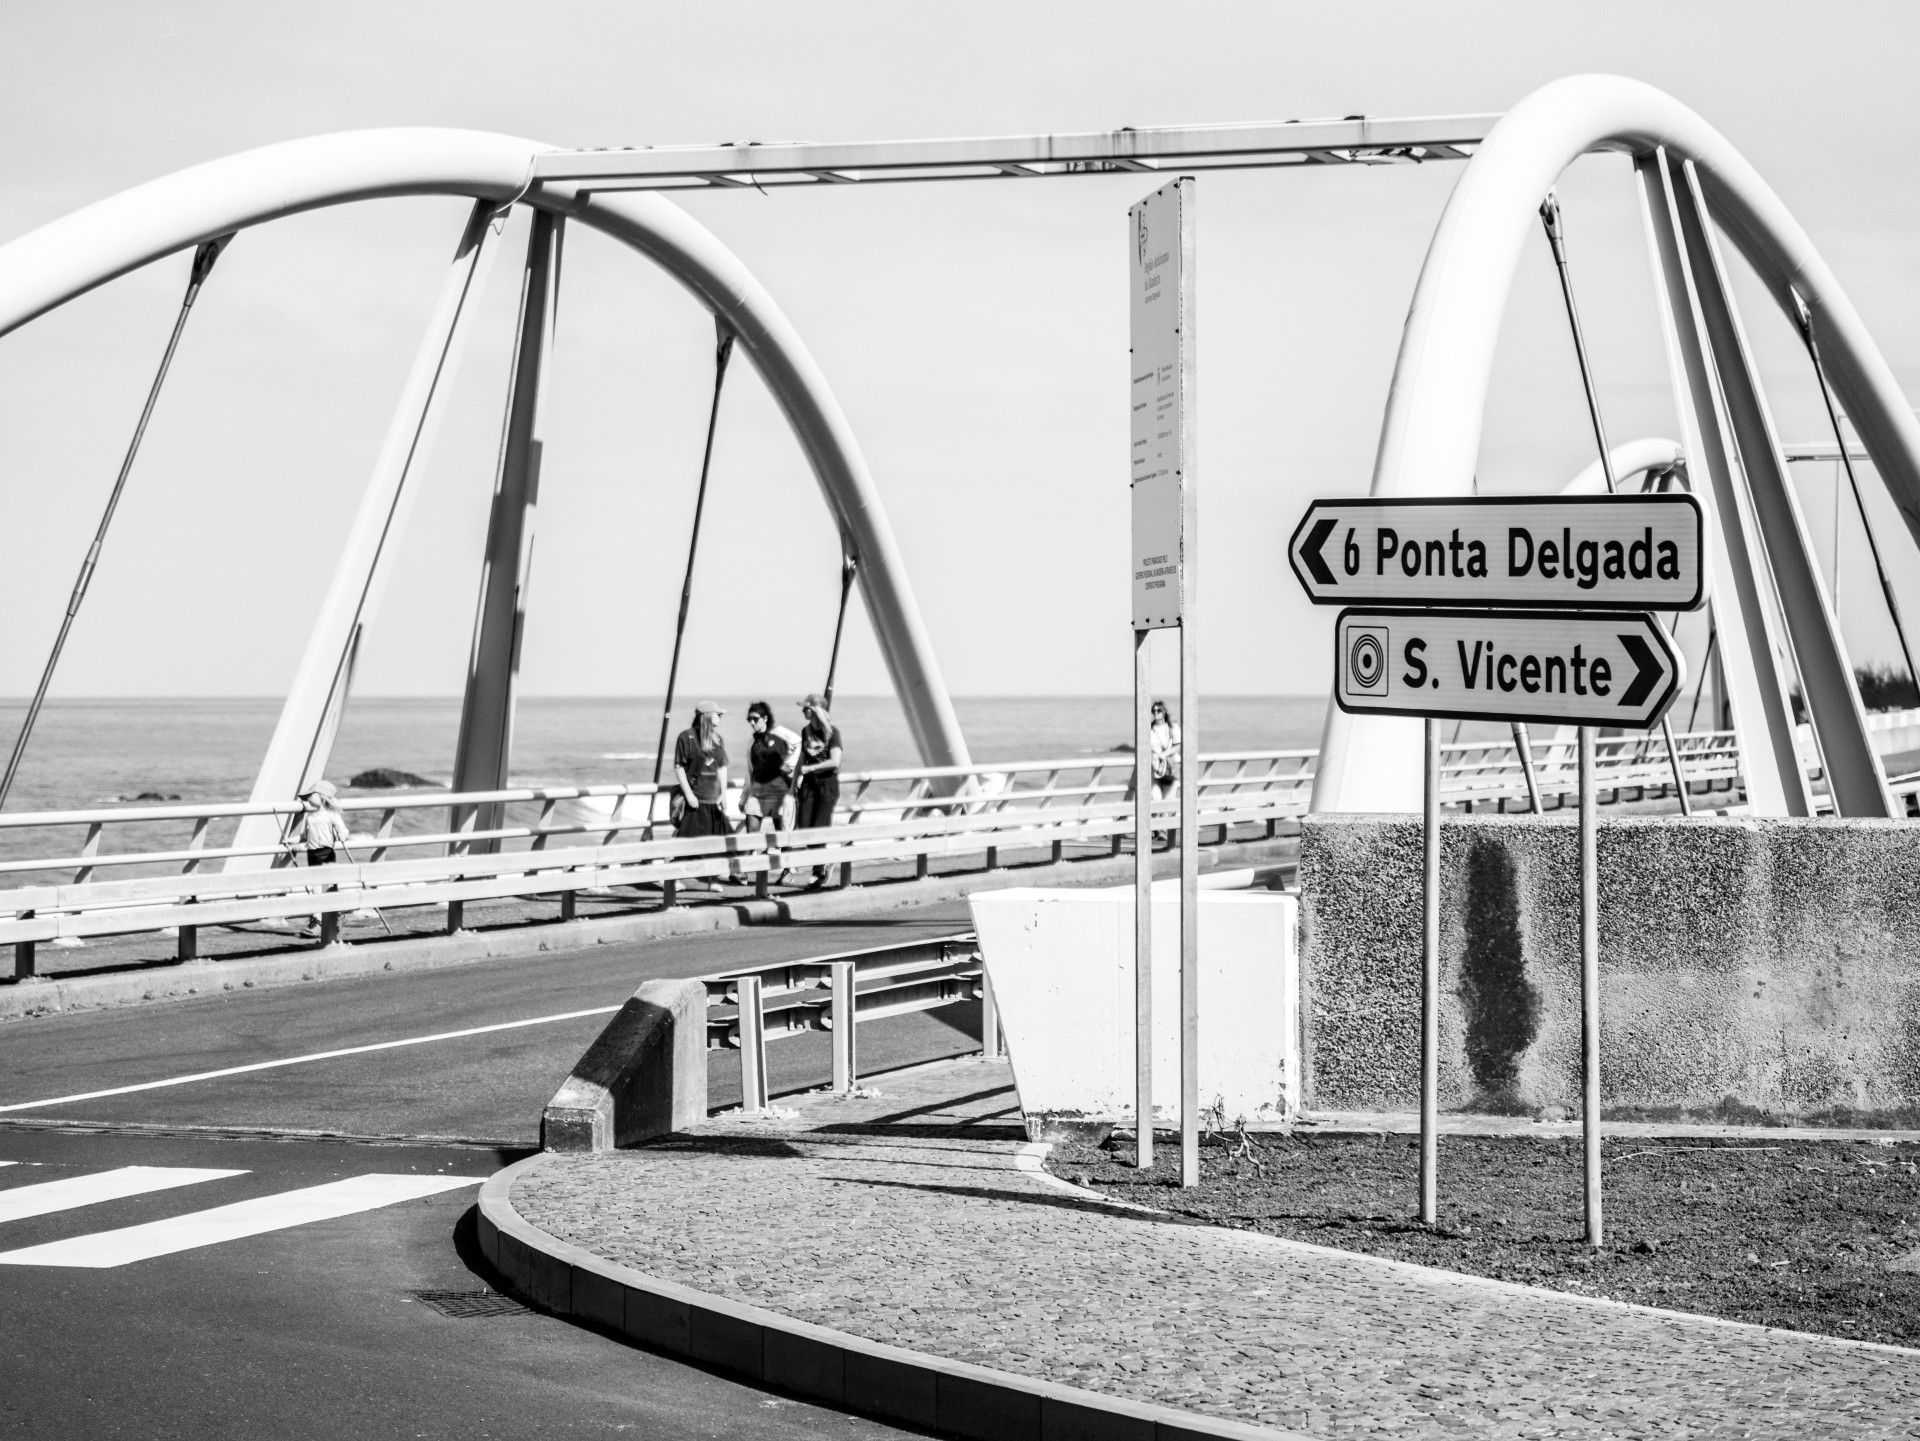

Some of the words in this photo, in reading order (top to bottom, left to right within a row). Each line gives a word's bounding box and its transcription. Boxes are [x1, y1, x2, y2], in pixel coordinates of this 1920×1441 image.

[1344, 527, 1360, 576] 6
[1376, 527, 1488, 578] Ponta
[1508, 526, 1680, 590] Delgada
[1402, 637, 1440, 689] S.
[1456, 639, 1612, 697] Vicente
